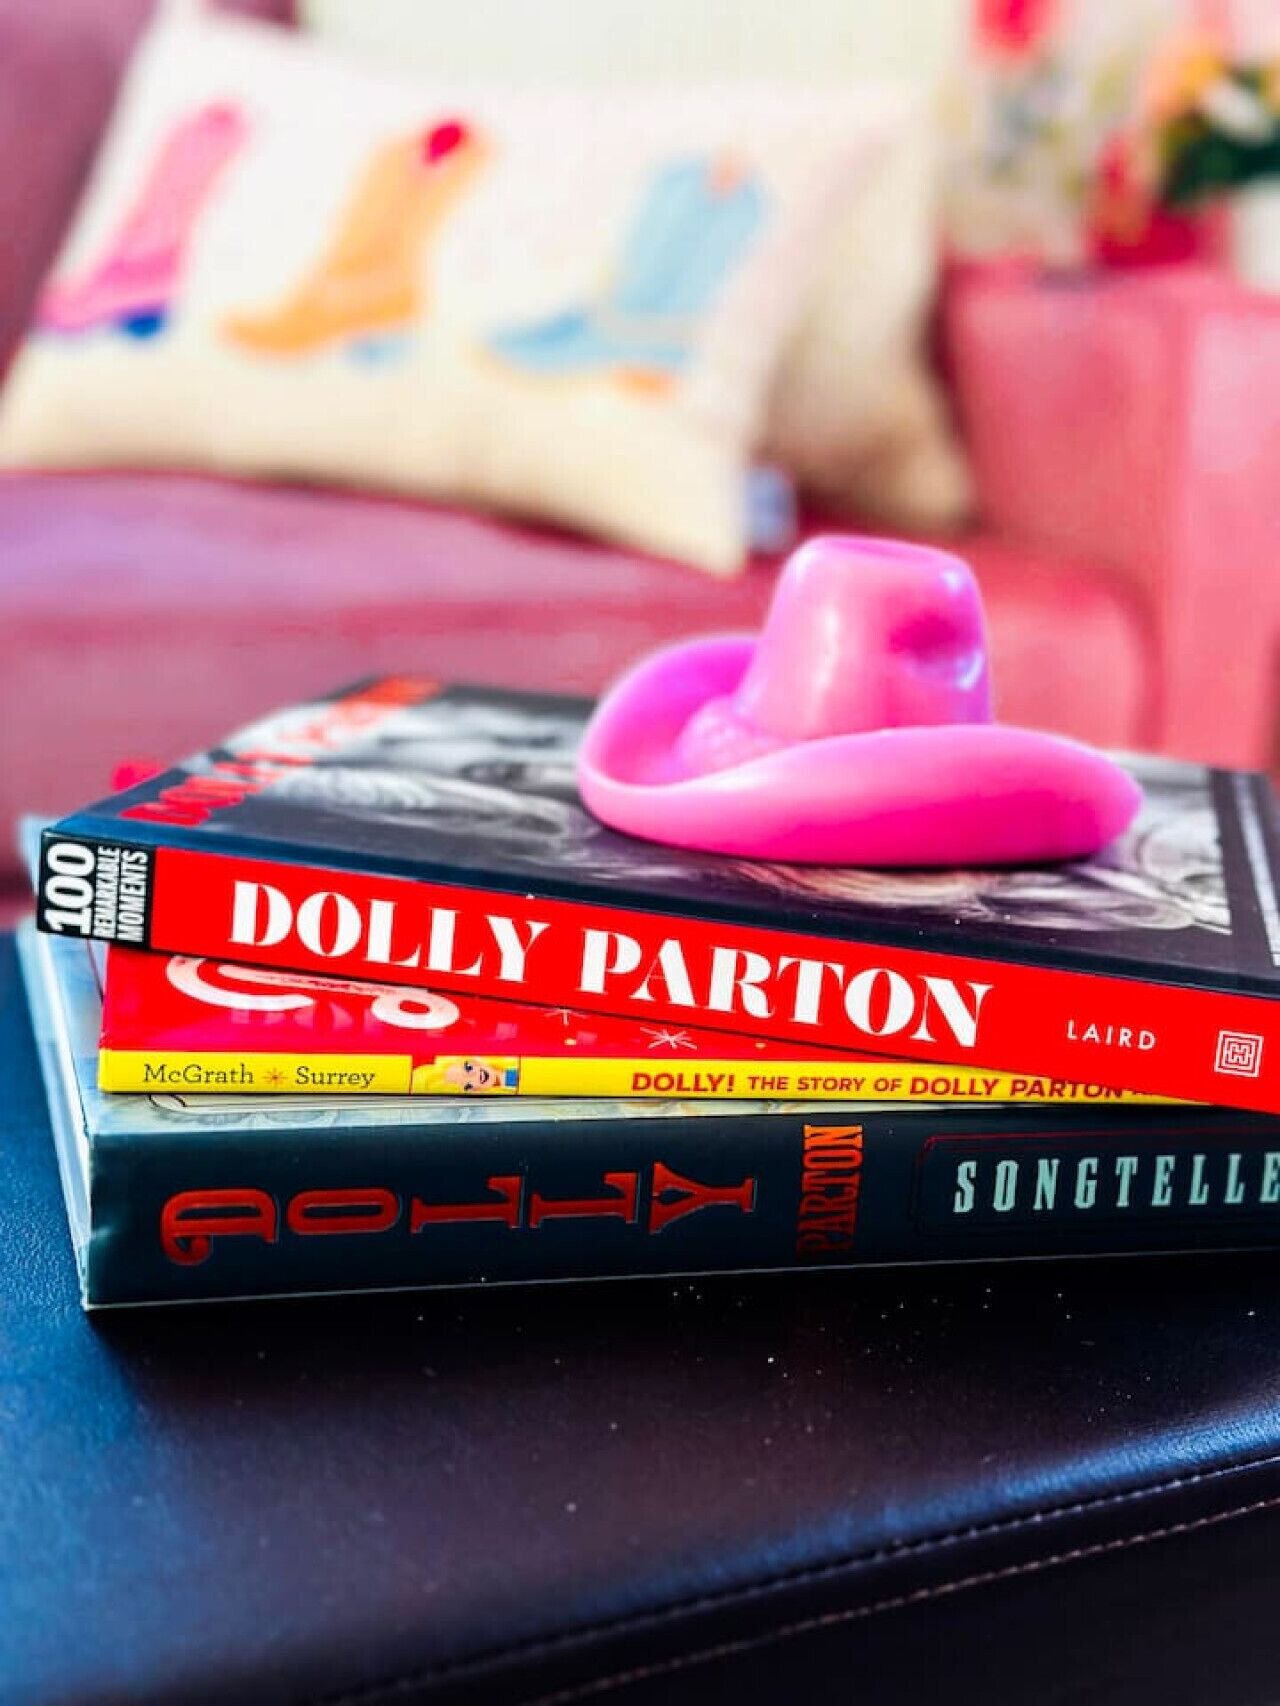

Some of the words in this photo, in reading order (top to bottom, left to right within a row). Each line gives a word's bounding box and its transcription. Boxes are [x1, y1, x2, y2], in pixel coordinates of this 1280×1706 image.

[44, 842, 95, 935] 100
[92, 846, 120, 939] REMARKABLE
[117, 850, 148, 942] MOMENTS
[228, 880, 550, 982] DOLLY
[575, 928, 993, 1048] PARTON
[143, 1063, 254, 1085] McGrath
[295, 1066, 376, 1088] Surrey
[1067, 1019, 1156, 1050] LAIRD
[631, 1072, 735, 1092] DOLLY!
[747, 1076, 789, 1091] THE
[796, 1076, 866, 1092] STORY
[873, 1077, 902, 1092] OF
[909, 1076, 1000, 1096] DOLLY
[160, 1161, 756, 1266] DOLLY
[795, 1124, 863, 1264] PARTON
